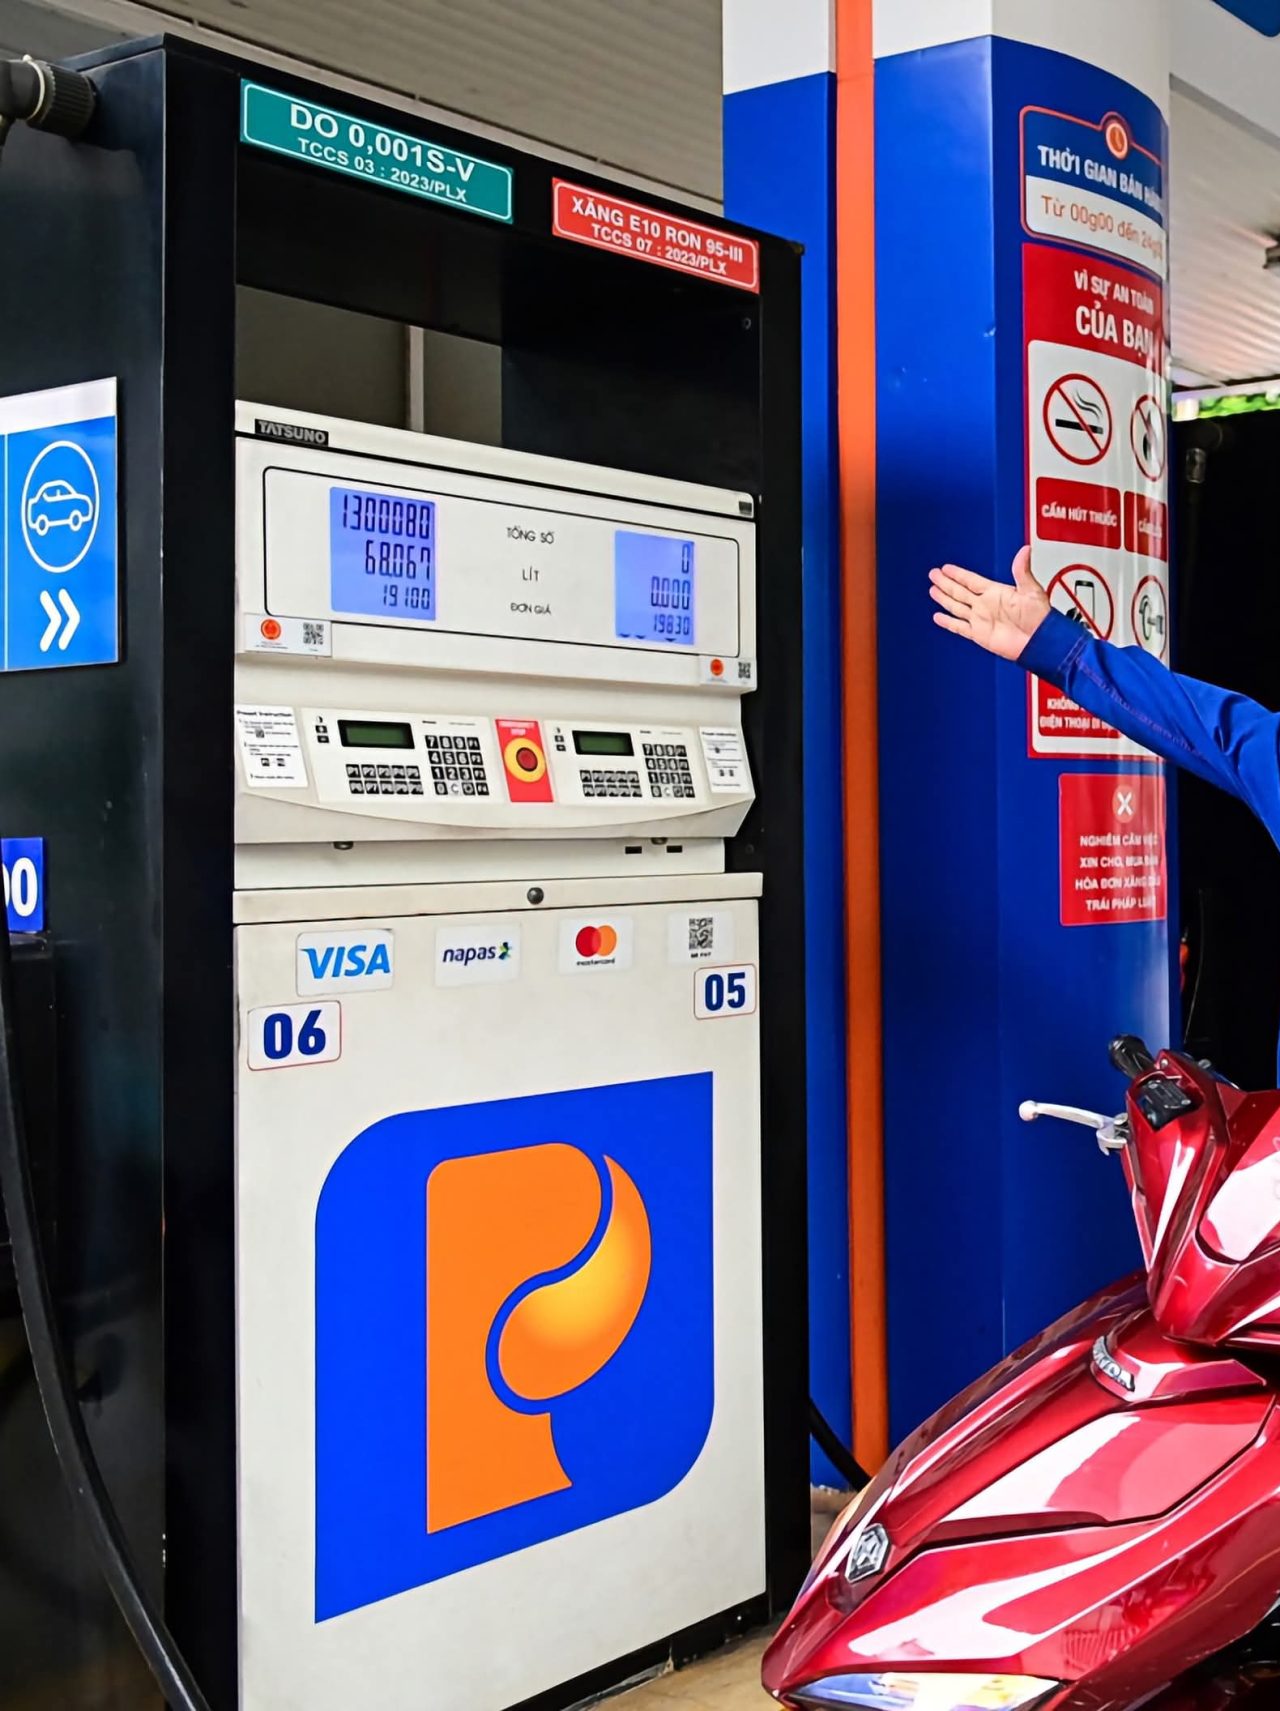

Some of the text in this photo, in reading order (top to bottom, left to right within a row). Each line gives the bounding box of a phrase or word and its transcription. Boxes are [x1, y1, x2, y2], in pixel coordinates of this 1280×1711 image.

[290, 103, 475, 182] DO 0,001S-V
[297, 137, 349, 166] TCCS
[354, 156, 375, 174] 03
[390, 167, 467, 203] 2023/PLX
[1037, 144, 1080, 175] THỜI
[1084, 159, 1117, 189] GIAN
[1120, 173, 1142, 200] BÁN
[572, 197, 743, 263] XĂNG E10 RON 95-III
[1041, 194, 1065, 217] Từ
[1070, 203, 1114, 233] 00g00
[1117, 220, 1140, 244] đến
[591, 223, 632, 248] TCCS
[636, 237, 652, 253] 07
[665, 245, 726, 275] 2023/PLX
[1074, 268, 1088, 291] VÌ
[1091, 275, 1111, 300] SỰ
[1113, 283, 1129, 304] AN
[1076, 300, 1153, 357] CỦA BẠN
[258, 420, 326, 444] TATSUNO
[342, 494, 431, 540] 1300080
[1041, 501, 1118, 527] CẤM HÚT THUỐC
[506, 525, 555, 545] TỔNG SỐ
[522, 566, 540, 582] LÍT
[681, 544, 691, 574] 0
[510, 602, 552, 616] ĐƠN GIÁ
[653, 614, 691, 636] 19830
[1039, 714, 1063, 729] ĐIỆN
[1064, 716, 1090, 730] THOẠI
[1080, 857, 1098, 868] XIN
[1086, 897, 1110, 911] TRÁI
[300, 943, 390, 979] VISA
[442, 945, 496, 966] napas
[705, 972, 745, 1011] 05
[263, 1009, 326, 1060] 06
